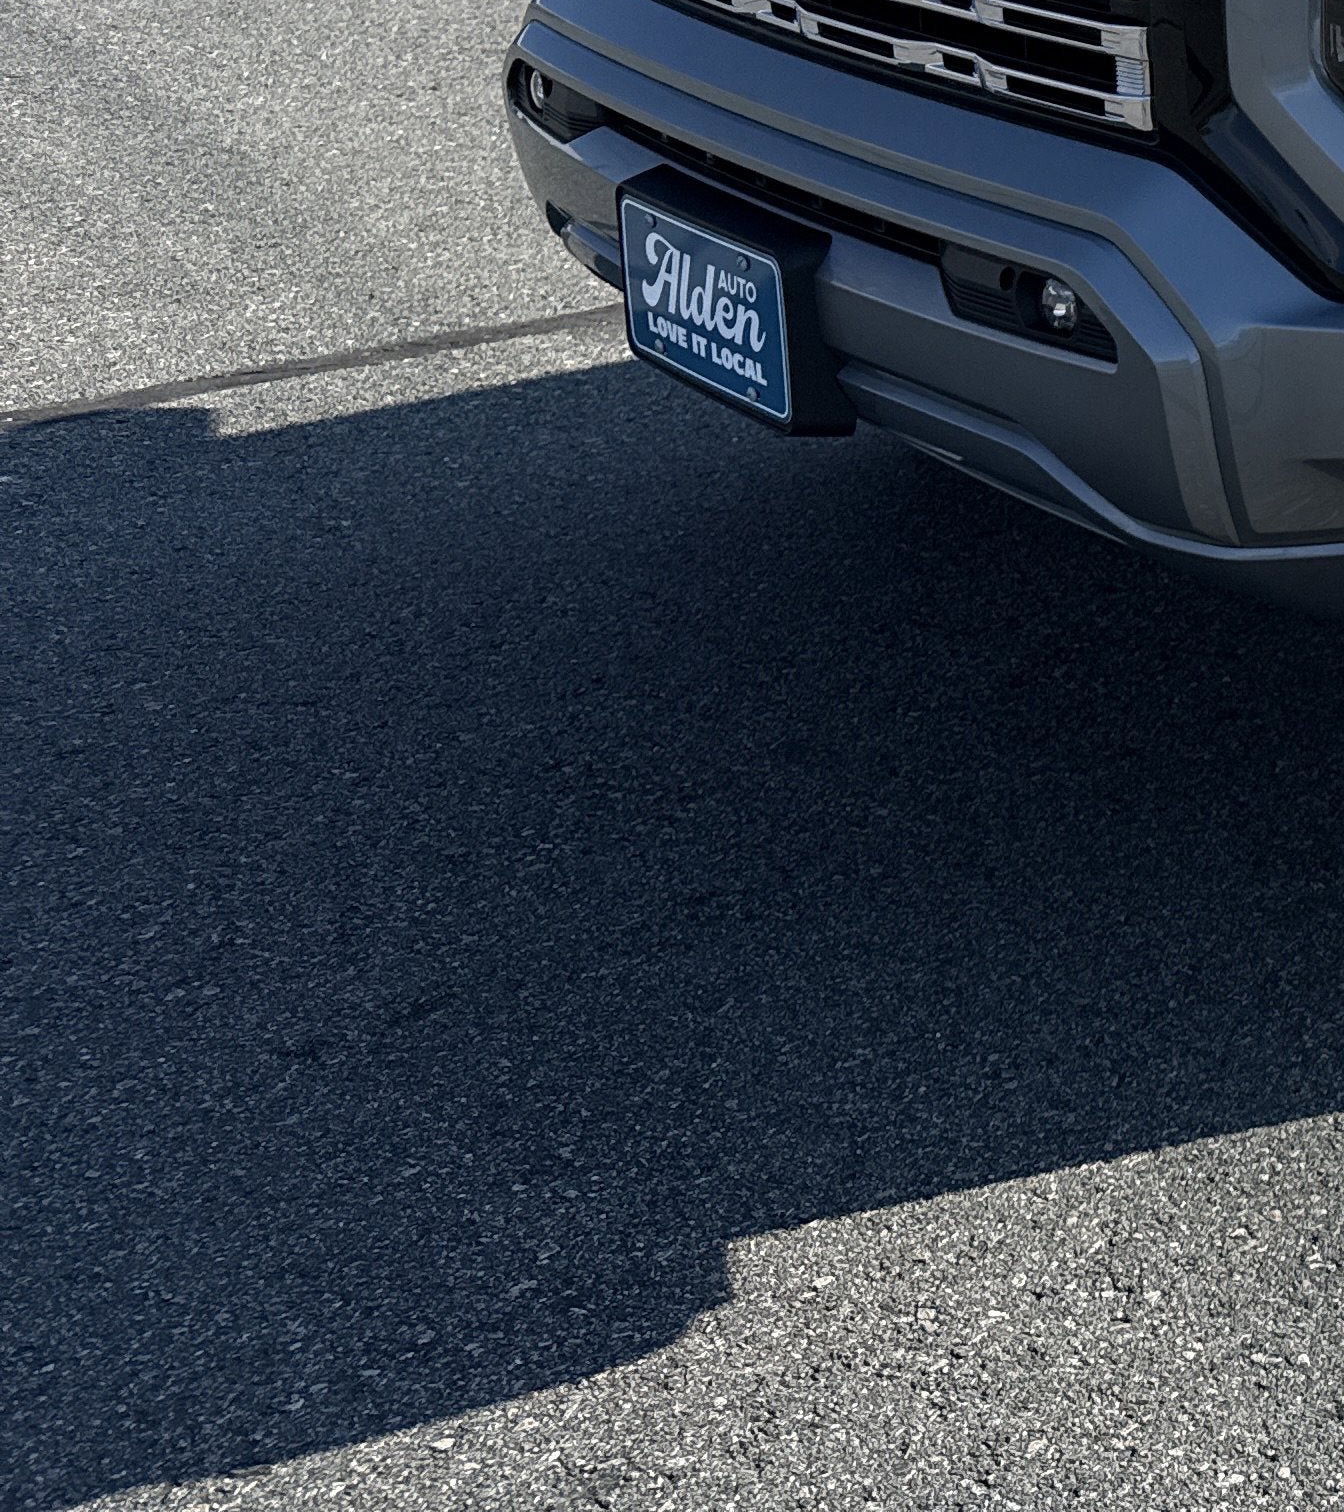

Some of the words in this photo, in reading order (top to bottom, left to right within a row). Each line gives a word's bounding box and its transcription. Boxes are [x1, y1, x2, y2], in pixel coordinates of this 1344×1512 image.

[641, 232, 766, 353] Alden
[717, 269, 757, 304] AUTO
[647, 311, 688, 349] LOVE
[691, 332, 708, 358] IT
[711, 342, 768, 387] LOCAL
